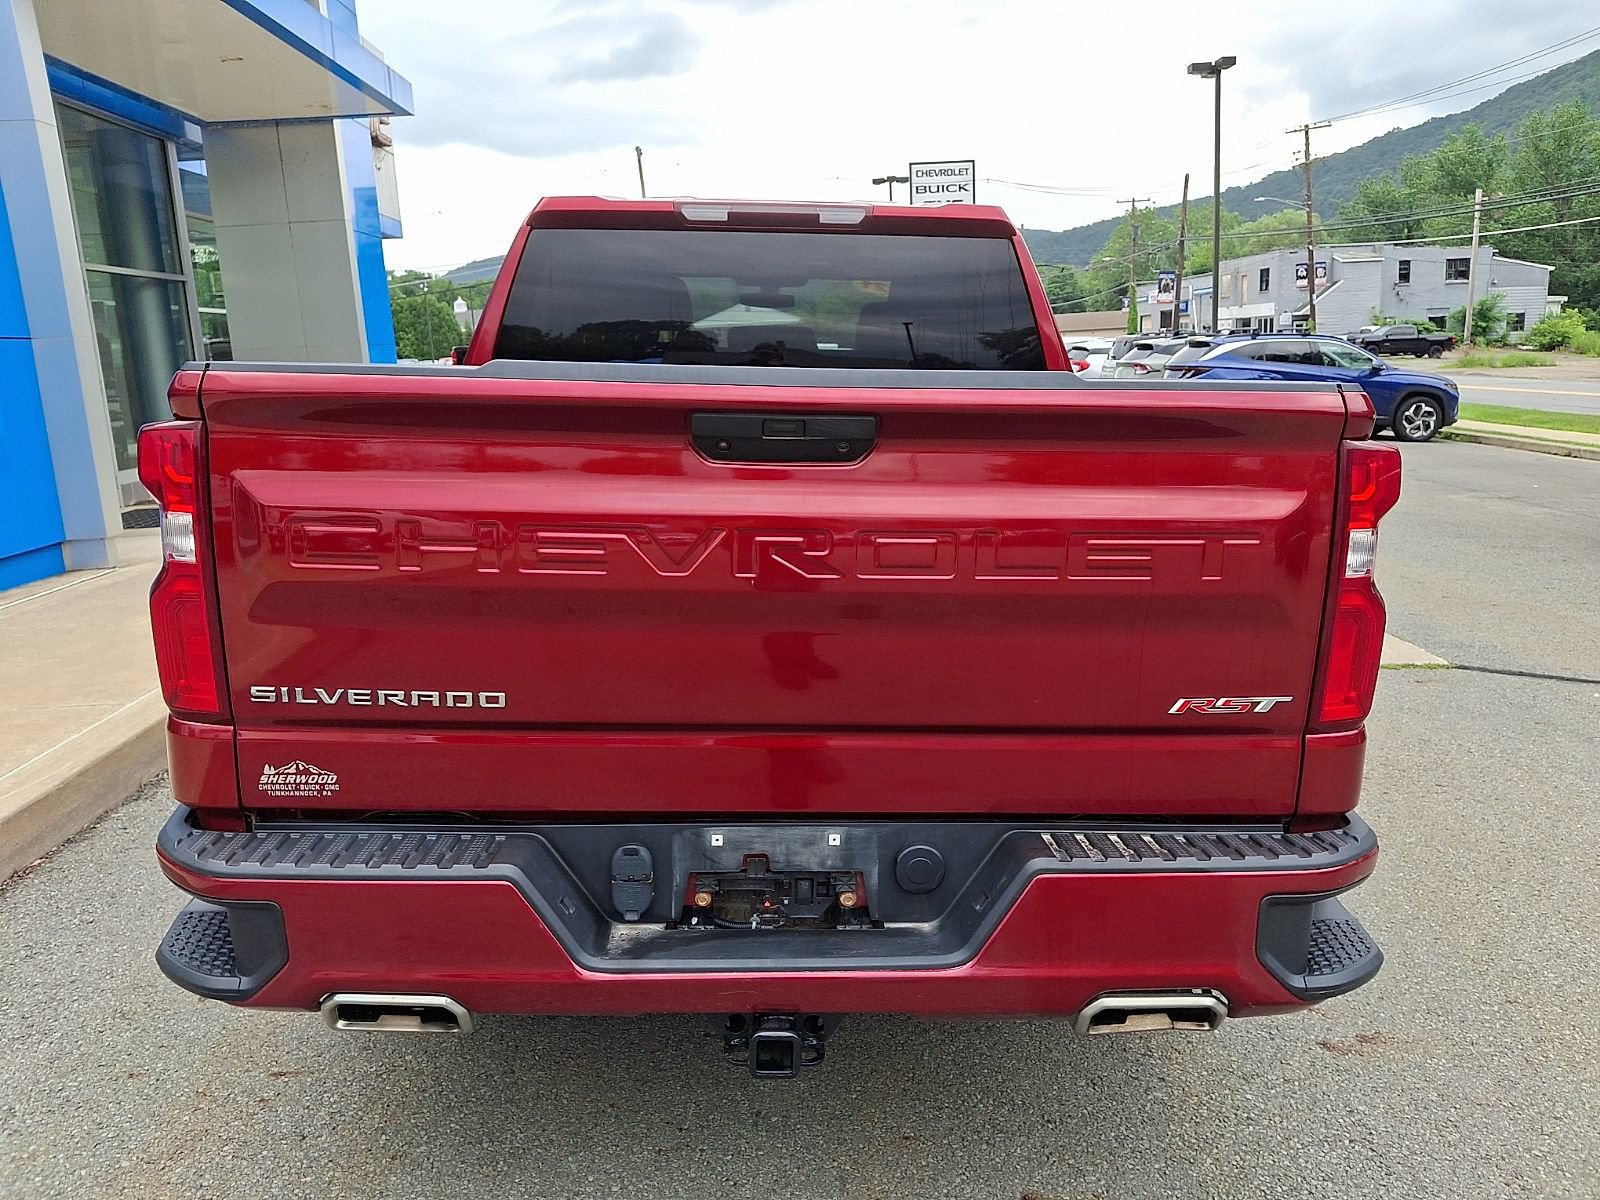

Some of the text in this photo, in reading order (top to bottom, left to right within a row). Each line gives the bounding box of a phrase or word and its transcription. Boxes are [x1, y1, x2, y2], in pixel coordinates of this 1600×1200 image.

[915, 167, 970, 178] CHEVROLET
[915, 183, 970, 194] BUICK
[284, 516, 1261, 581] CHEVROLET
[250, 685, 506, 708] SILVERADO
[1167, 696, 1294, 714] RST
[259, 774, 338, 784] SHERWOOD
